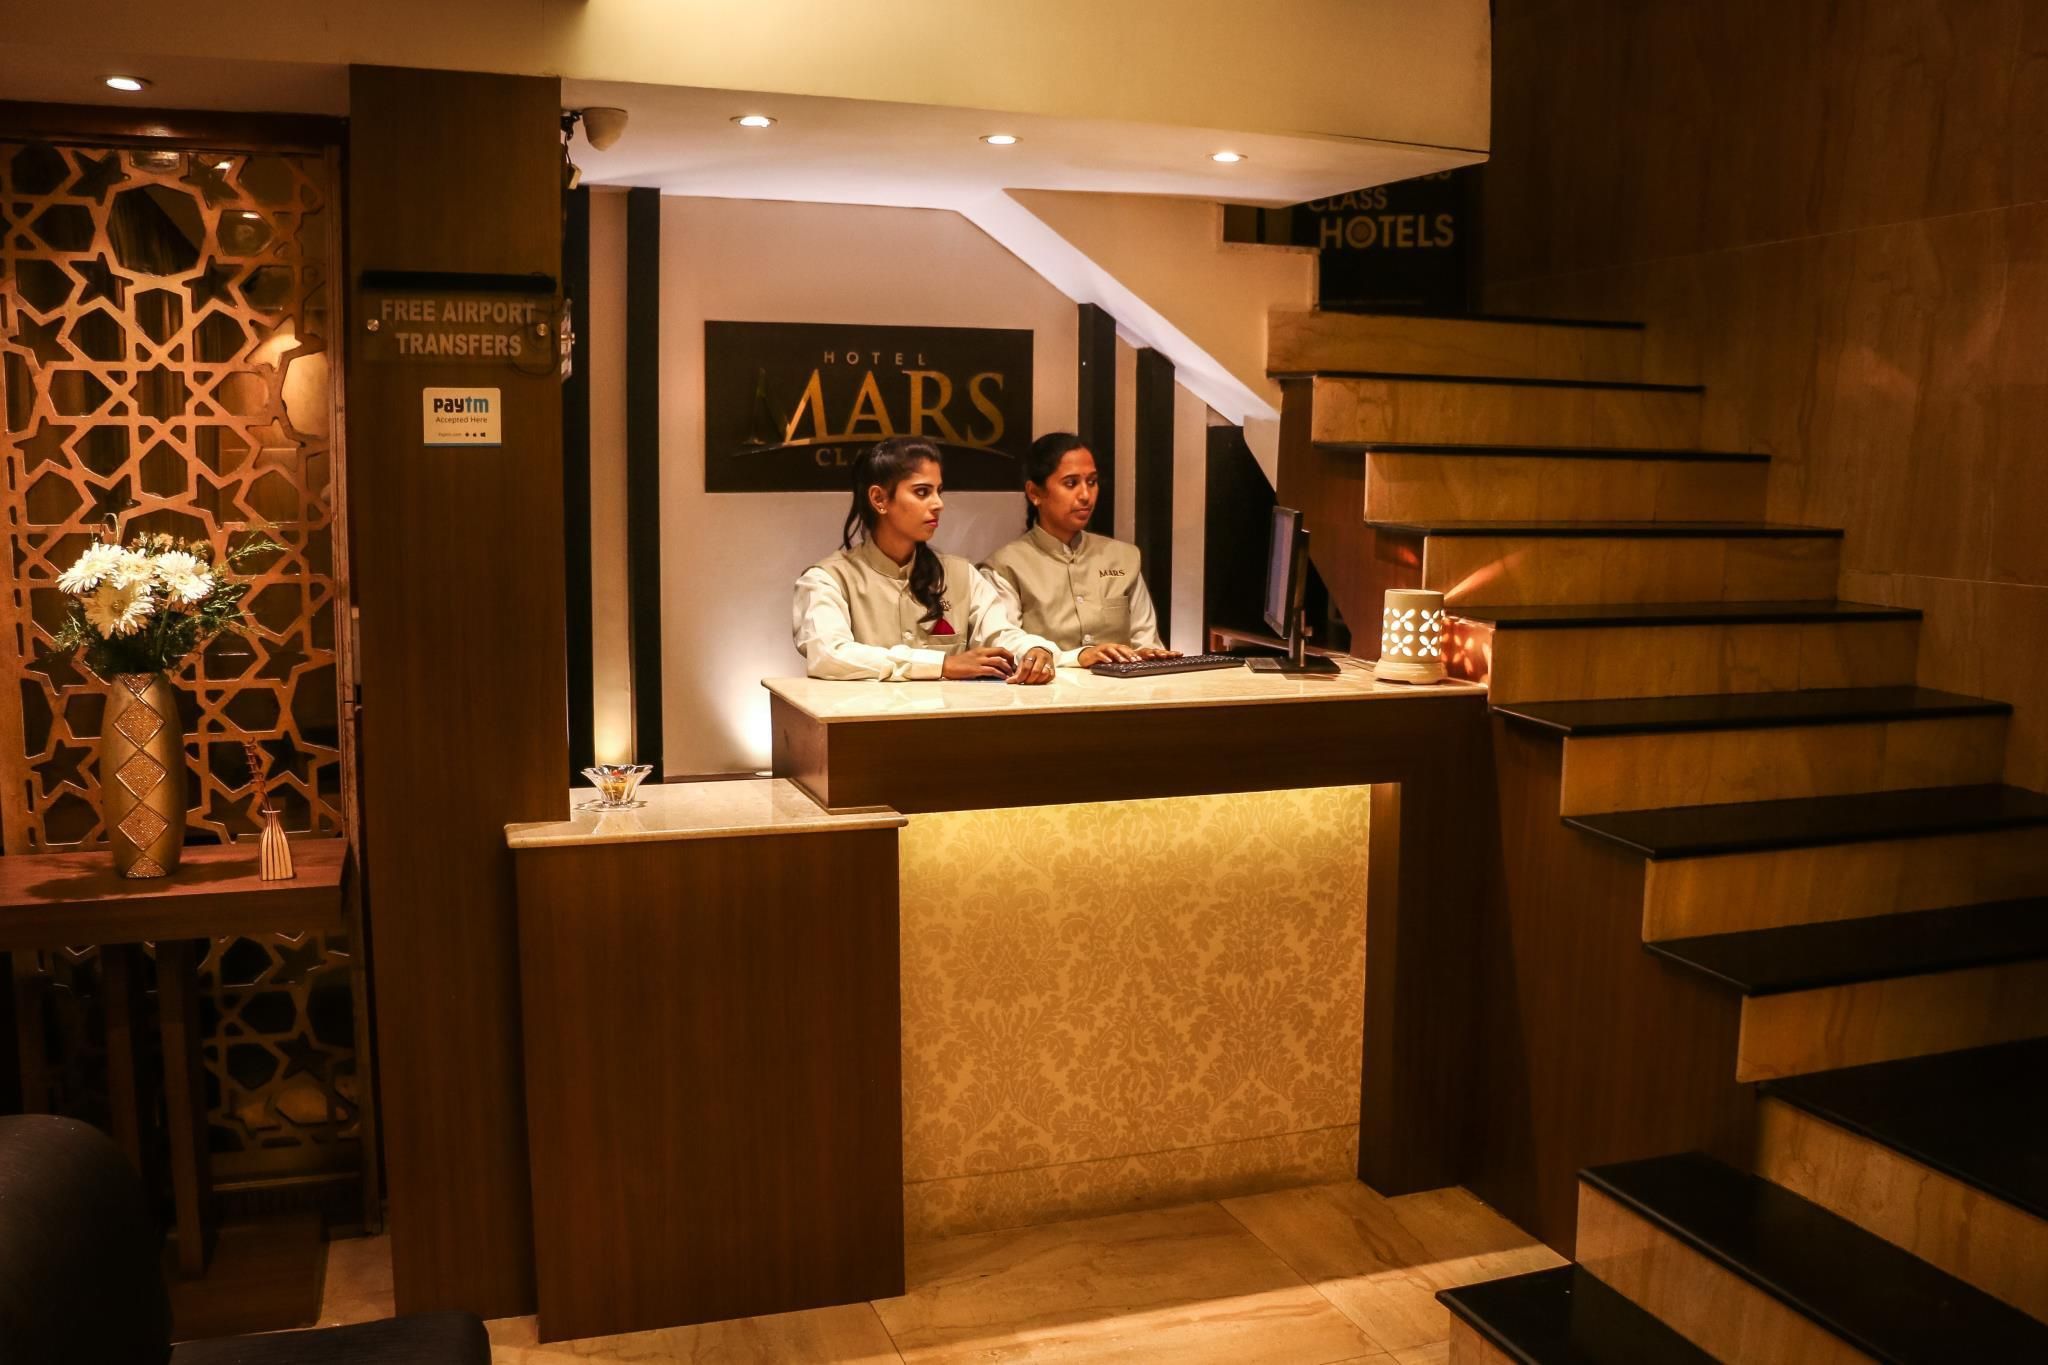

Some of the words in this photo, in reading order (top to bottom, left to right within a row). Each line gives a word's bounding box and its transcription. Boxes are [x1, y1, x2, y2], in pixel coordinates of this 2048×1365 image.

[1320, 214, 1454, 249] HOTELS
[381, 300, 436, 321] FREE
[442, 301, 536, 324] AIRPORT
[395, 333, 522, 356] TRANSFERS
[824, 351, 926, 366] HOTEL
[742, 367, 1005, 447] MARS
[435, 416, 469, 424] Accepted
[1099, 569, 1126, 577] MARS
